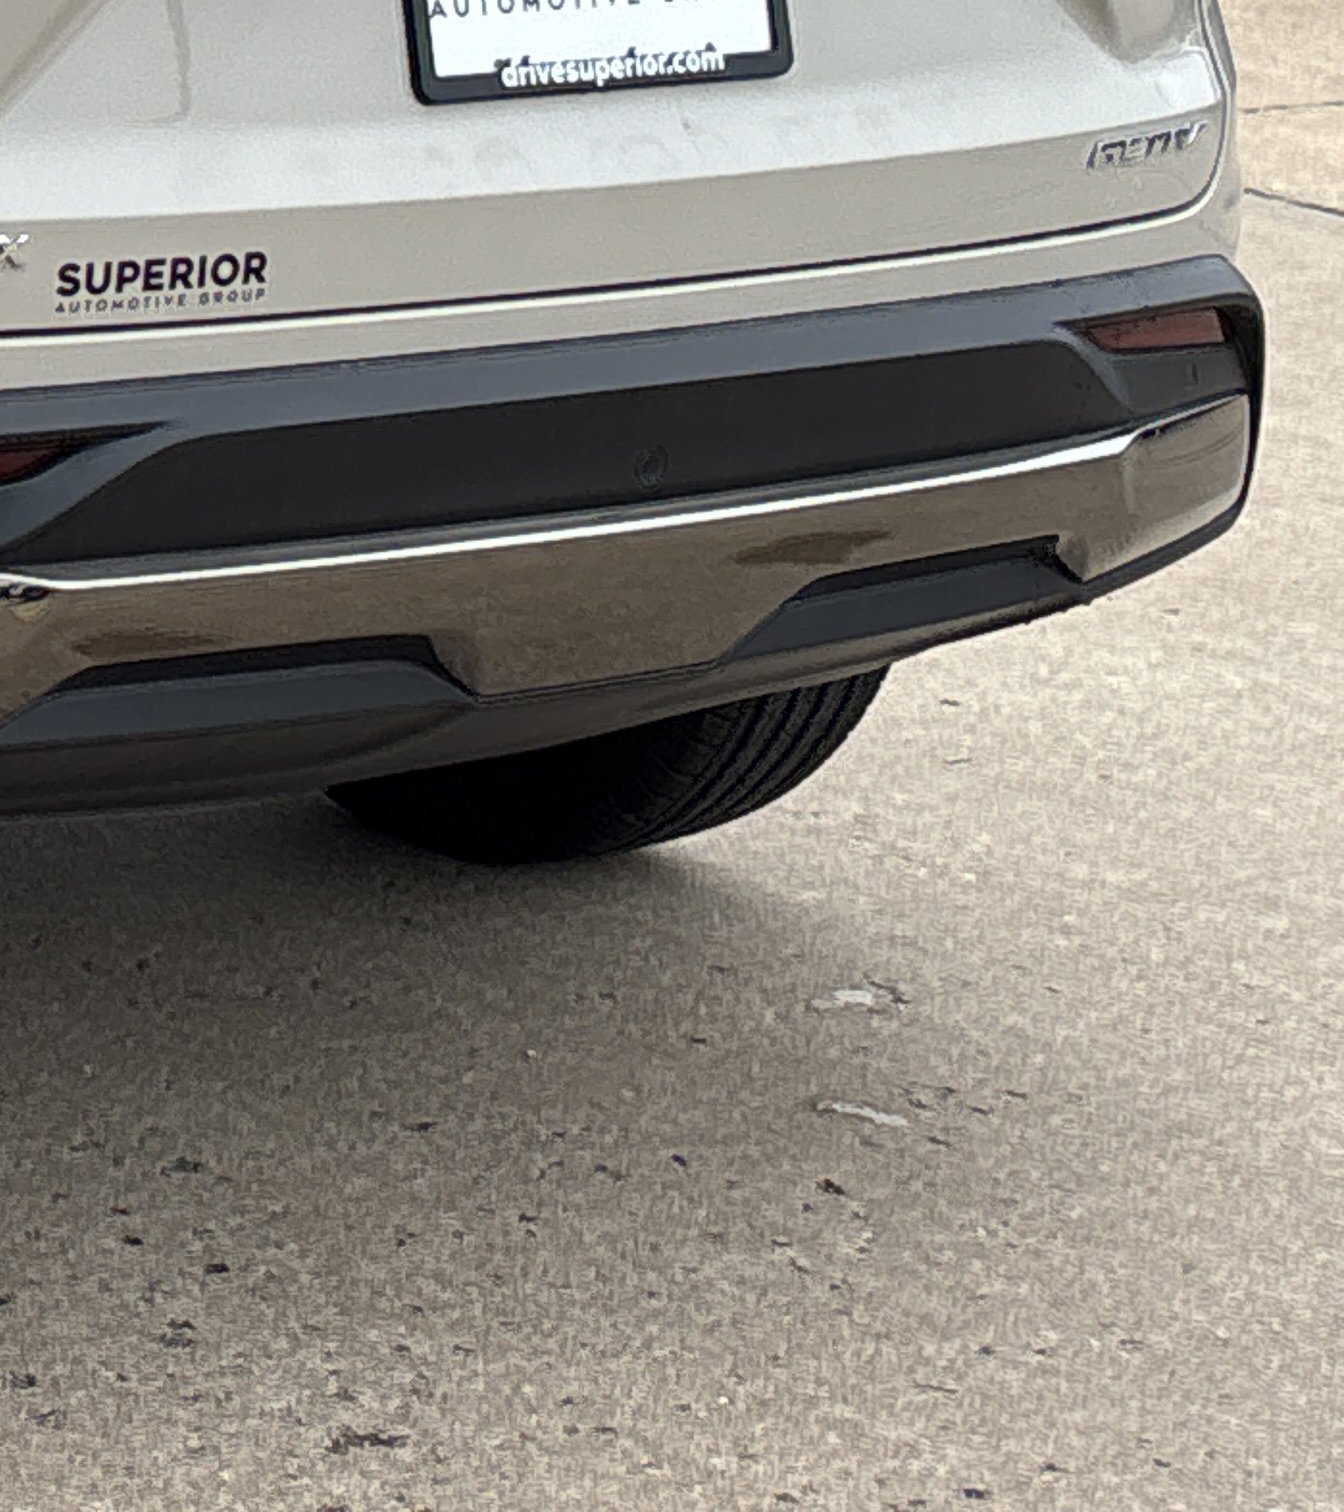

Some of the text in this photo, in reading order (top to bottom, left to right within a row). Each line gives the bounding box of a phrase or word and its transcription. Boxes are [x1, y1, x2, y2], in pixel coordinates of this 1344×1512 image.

[500, 44, 725, 88] drivesuperior.com
[55, 251, 268, 297] SUPERIOR
[55, 287, 267, 313] AUTOMOTIVE GROUP
